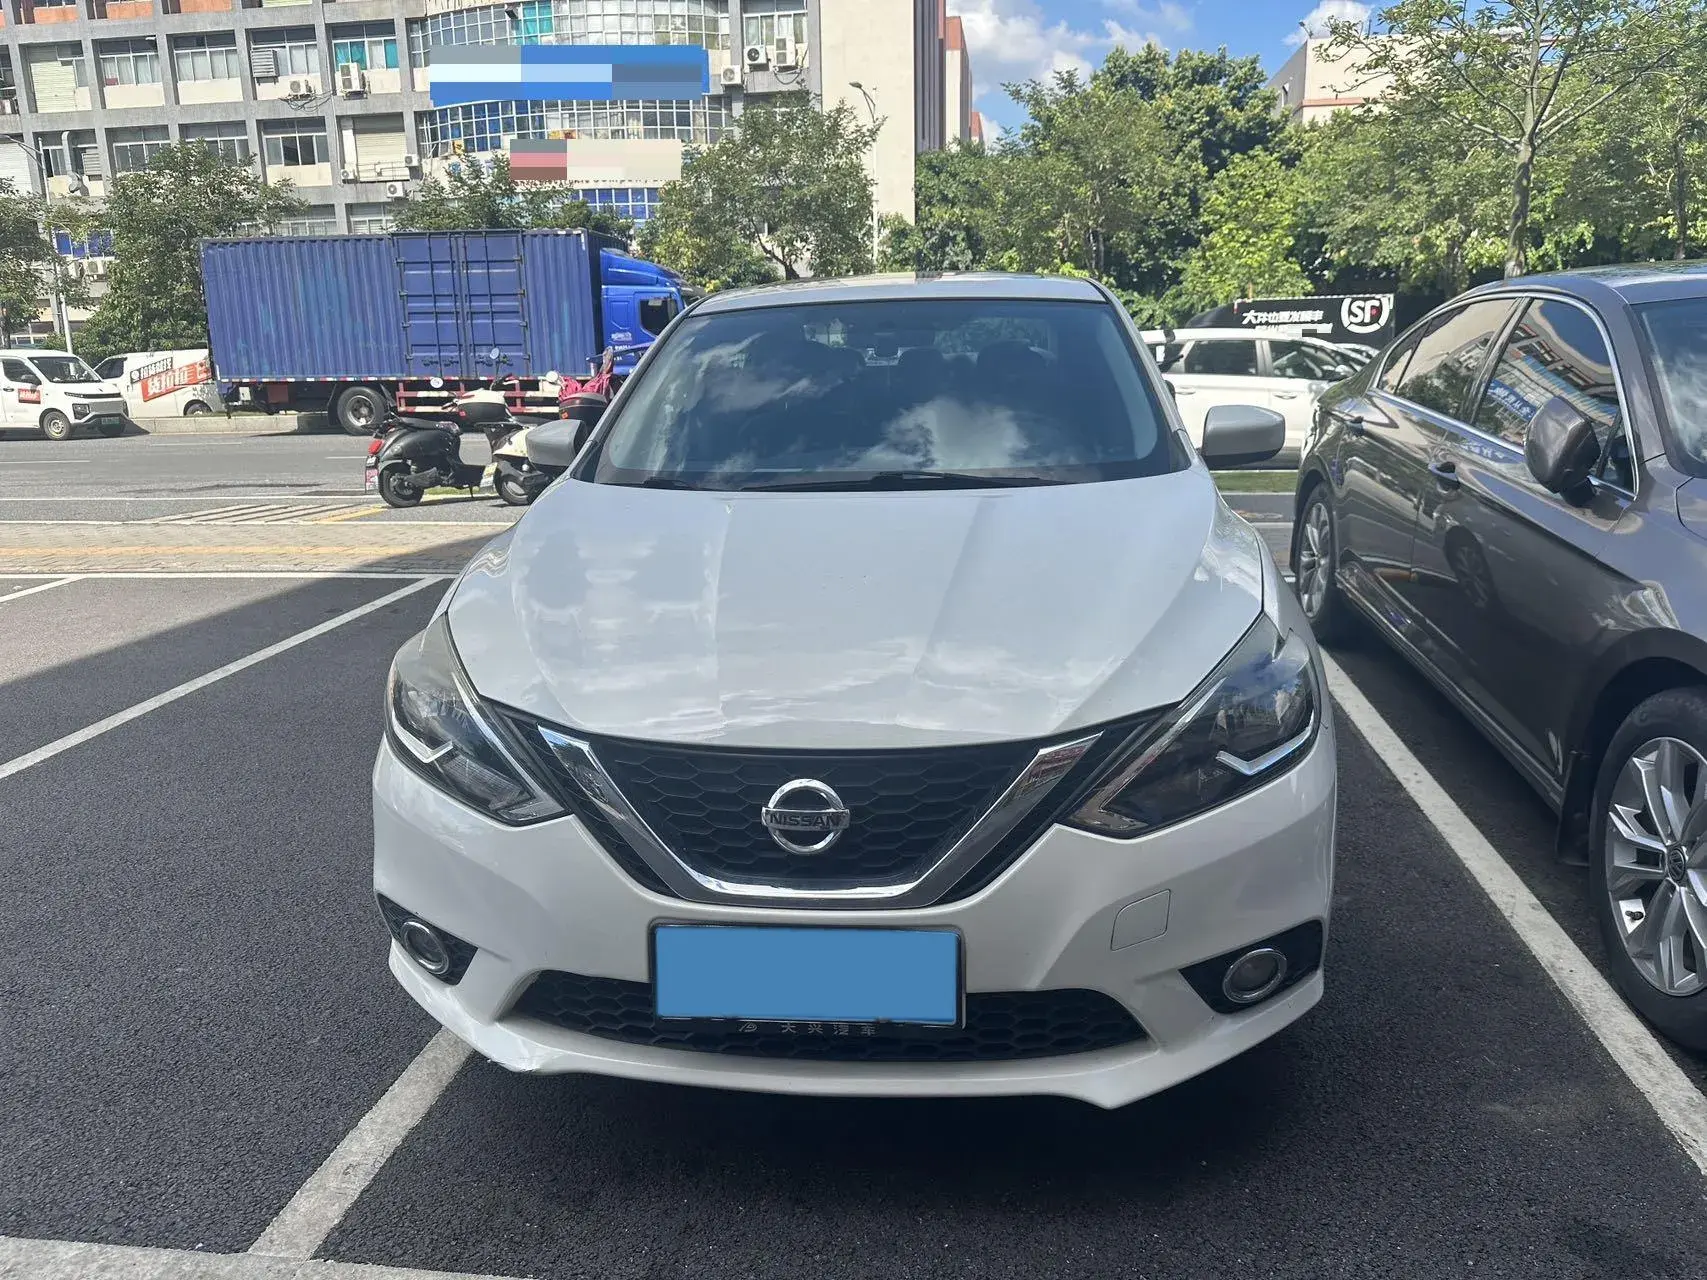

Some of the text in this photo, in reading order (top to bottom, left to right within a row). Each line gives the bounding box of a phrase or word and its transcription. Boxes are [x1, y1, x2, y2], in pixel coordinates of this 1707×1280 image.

[1350, 299, 1380, 323] SF
[768, 812, 842, 829] NISSAN
[781, 1022, 876, 1037] 大兴汽车
